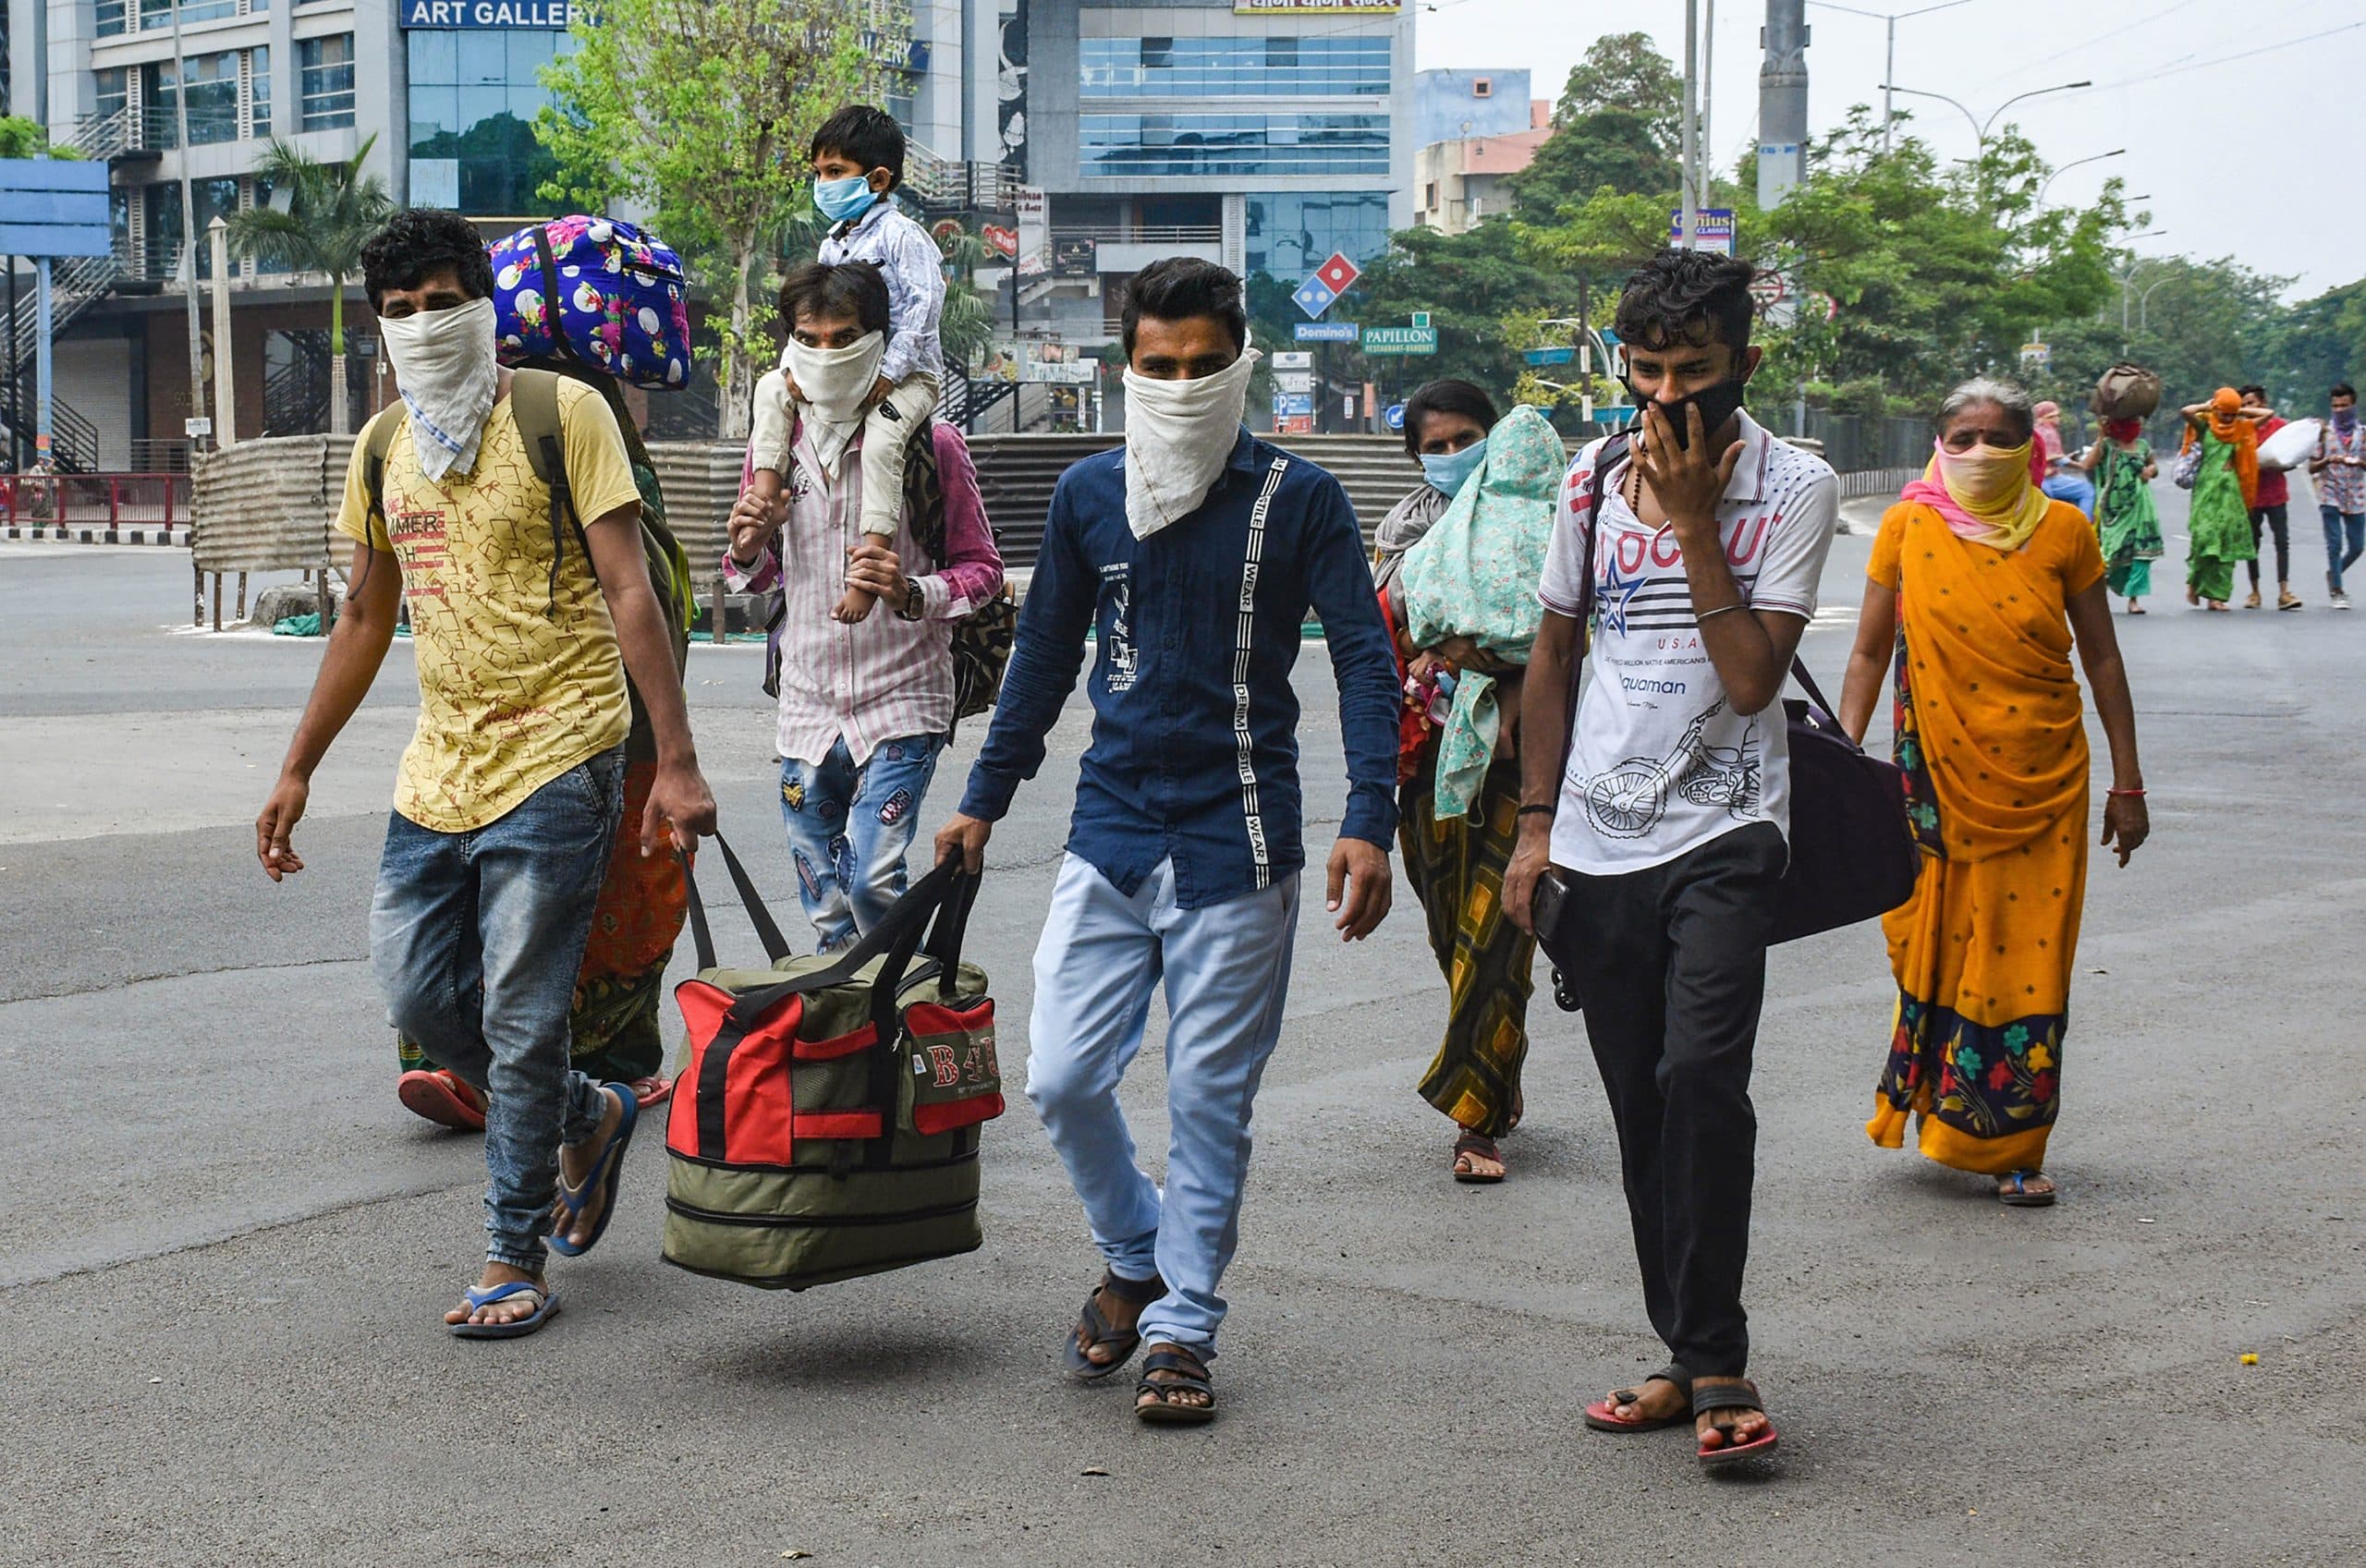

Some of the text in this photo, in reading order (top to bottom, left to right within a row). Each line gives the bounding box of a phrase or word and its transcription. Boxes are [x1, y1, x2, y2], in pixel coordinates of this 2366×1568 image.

[411, 3, 467, 24] ART
[1298, 326, 1353, 338] Domino's
[1366, 330, 1433, 343] PAPILLON
[1251, 495, 1269, 529] STILE
[1241, 565, 1257, 606] WEAR
[1236, 686, 1247, 728] DENIM
[1239, 752, 1254, 783] STILE
[1248, 818, 1266, 858] WEAR
